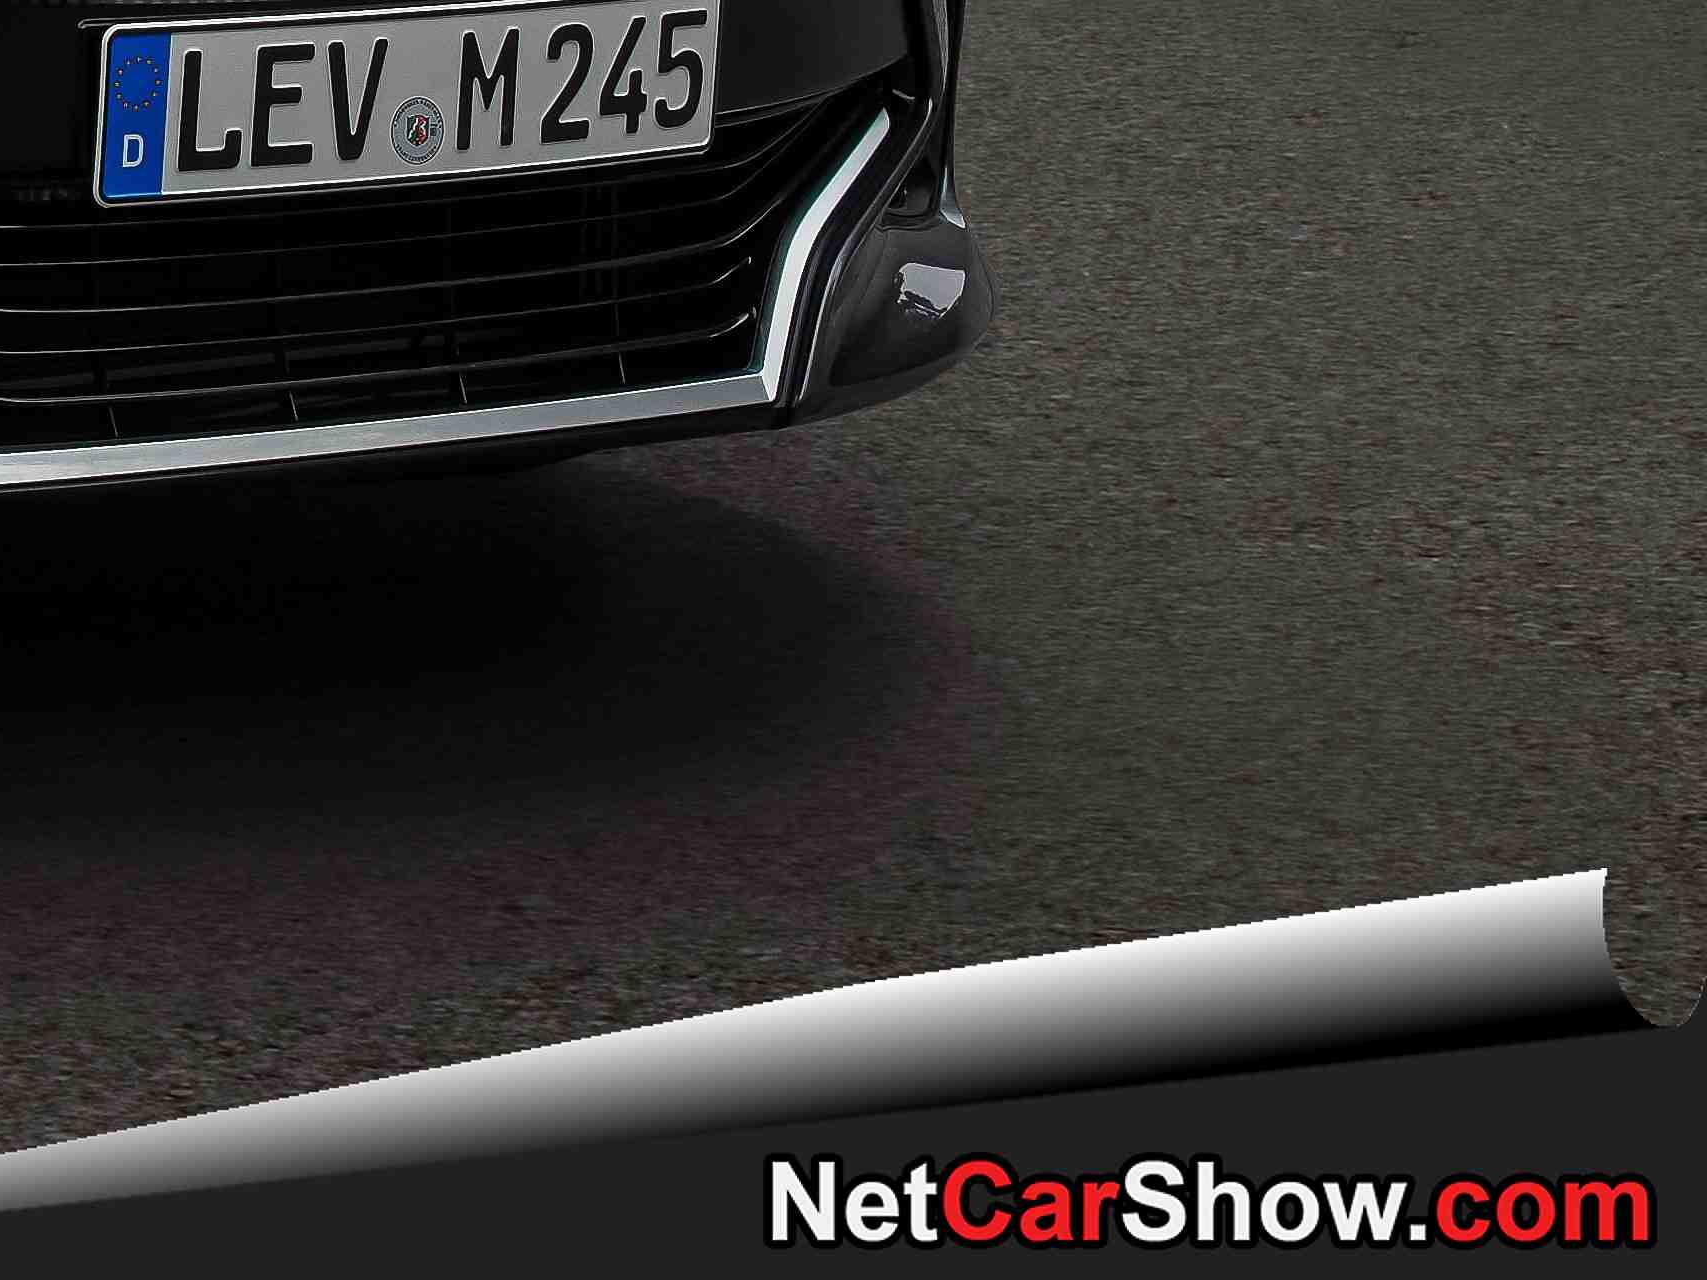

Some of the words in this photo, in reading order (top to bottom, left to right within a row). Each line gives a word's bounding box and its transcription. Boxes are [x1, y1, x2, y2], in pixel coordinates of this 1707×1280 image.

[178, 37, 388, 171] LEV
[456, 27, 519, 150] M
[540, 9, 708, 144] 245
[122, 134, 144, 167] D
